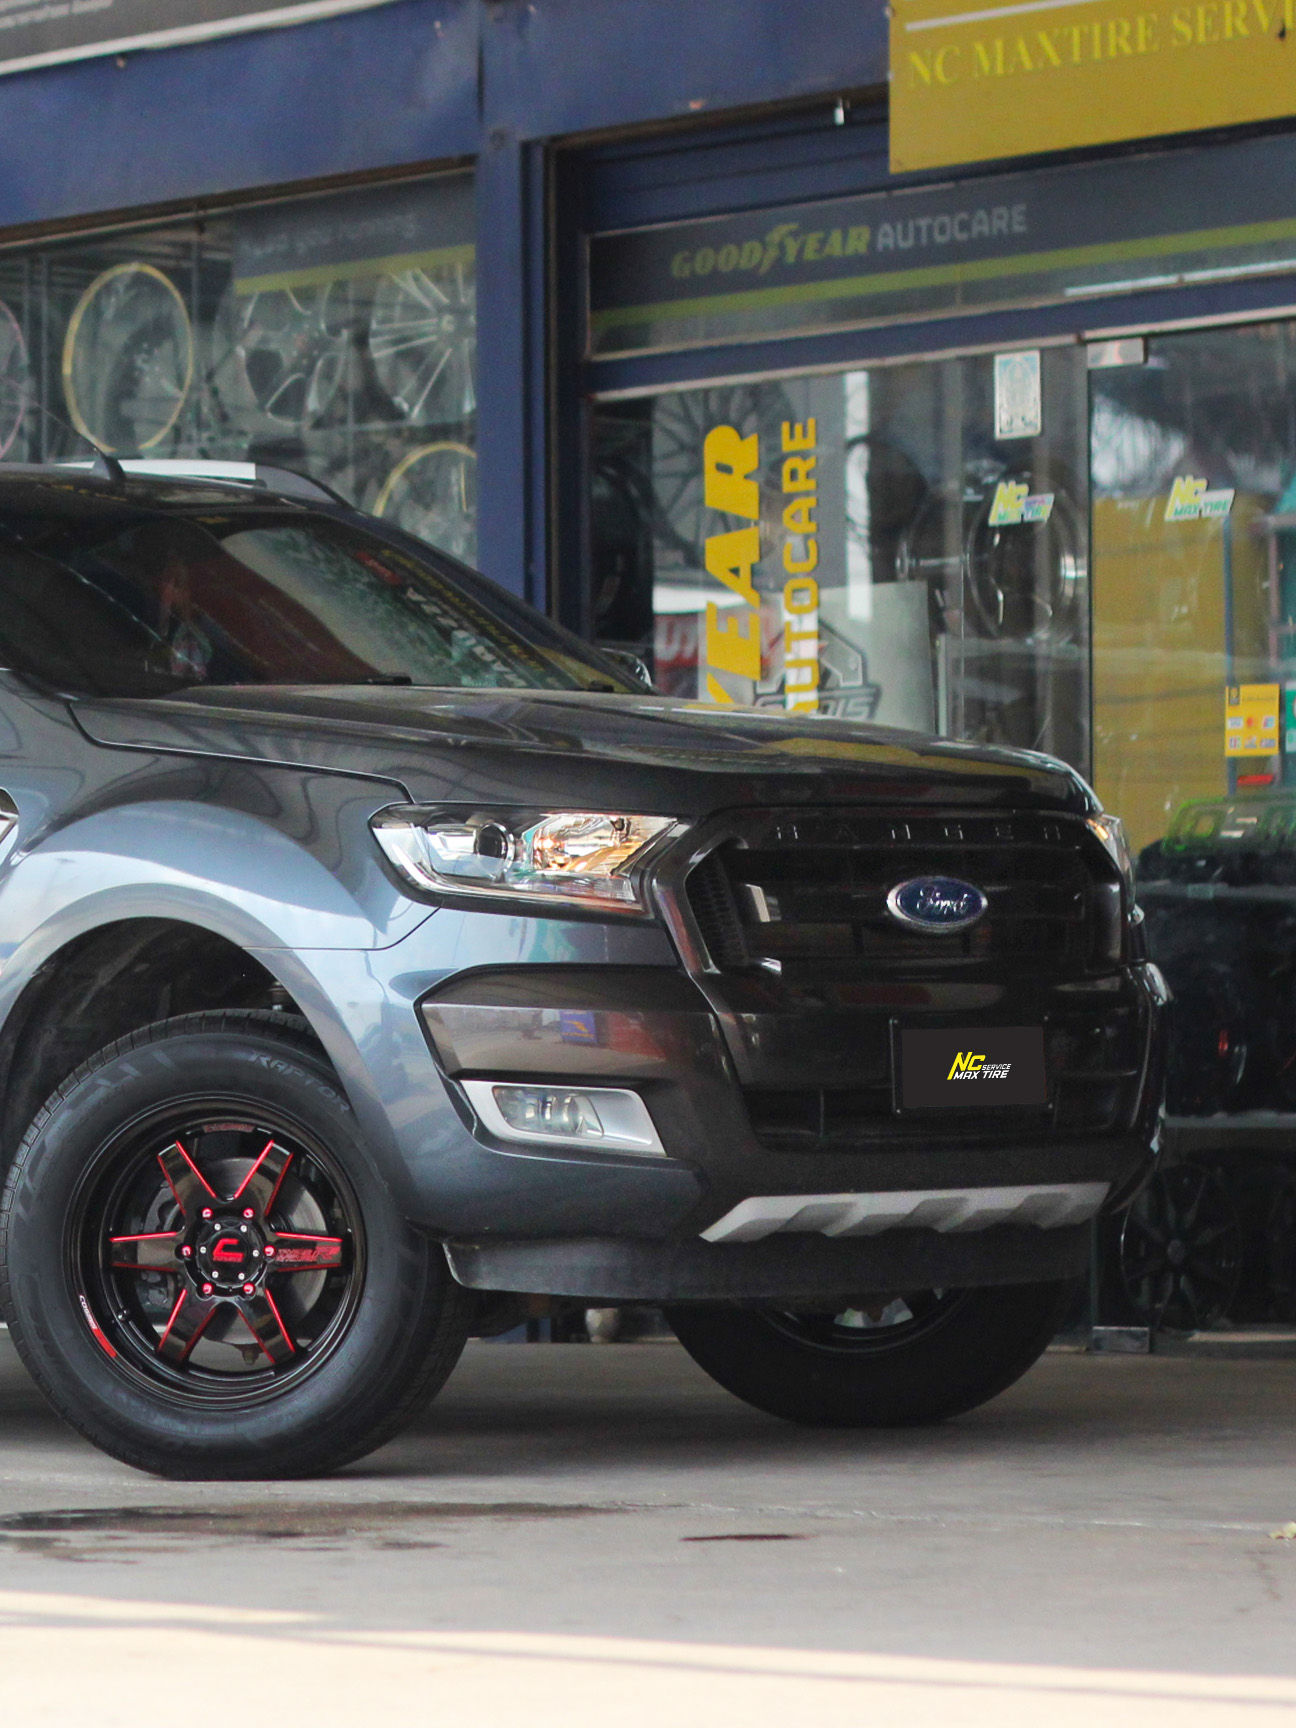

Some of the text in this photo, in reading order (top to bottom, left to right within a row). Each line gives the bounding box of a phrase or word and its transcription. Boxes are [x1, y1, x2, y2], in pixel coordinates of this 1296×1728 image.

[908, 46, 960, 88] NC
[974, 13, 1160, 79] MAXTIRE
[670, 204, 1027, 279] GOODYEAR AUTOCARE
